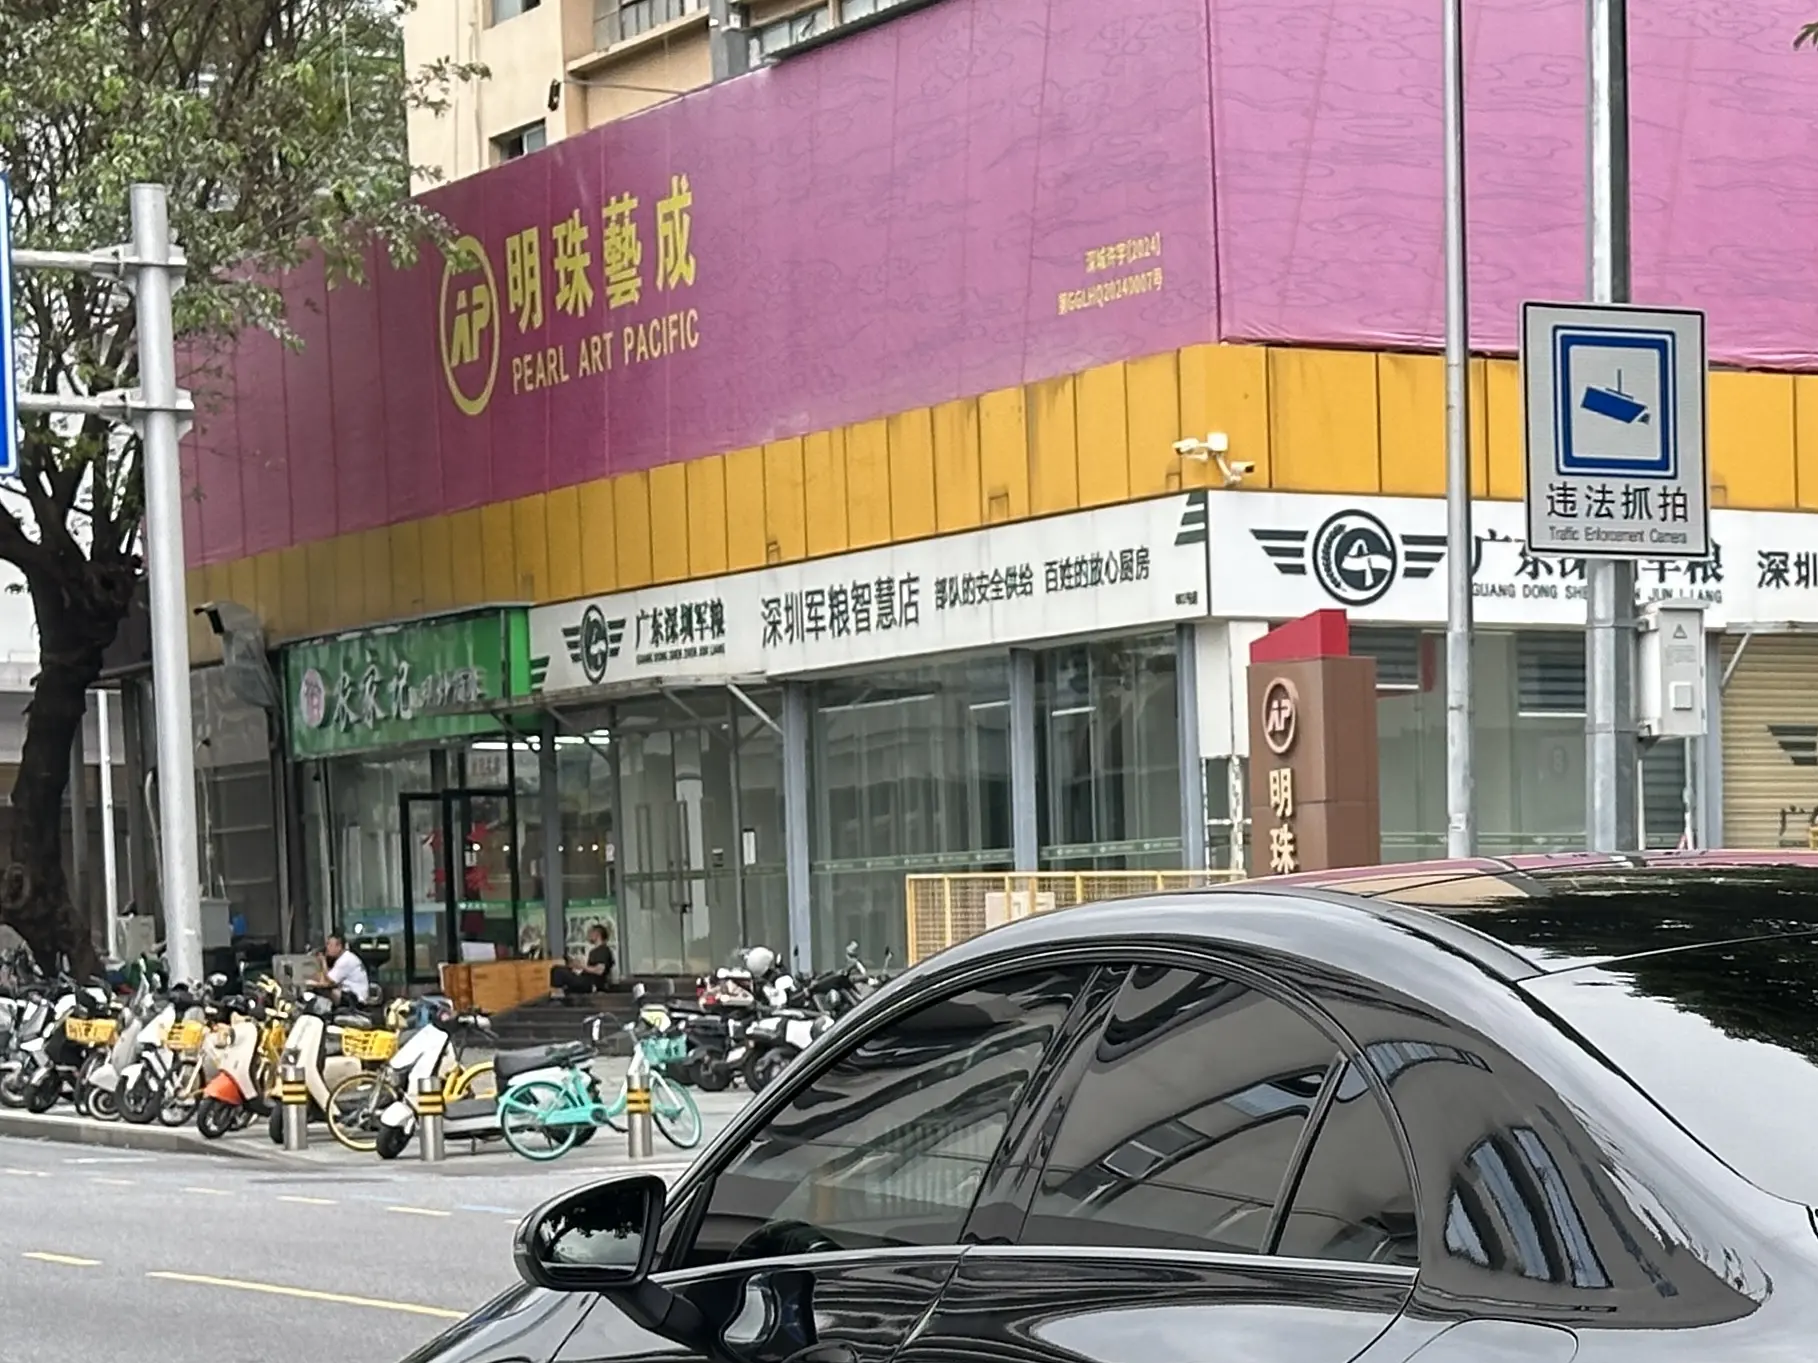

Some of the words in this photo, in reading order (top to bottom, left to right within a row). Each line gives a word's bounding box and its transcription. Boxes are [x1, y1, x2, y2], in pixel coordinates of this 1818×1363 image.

[506, 174, 696, 334] 明珠藝成
[512, 345, 570, 395] PEARL
[578, 331, 614, 378] ART
[623, 308, 700, 366] PACIFIC
[1546, 482, 1689, 523] 违法抓拍
[762, 572, 920, 649] 深圳军粮智慧店
[934, 562, 1034, 611] 部队的安全供给
[1044, 545, 1151, 594] 百姓的放心厨房
[1523, 585, 1558, 599] DONG
[1269, 767, 1297, 875] 明珠
